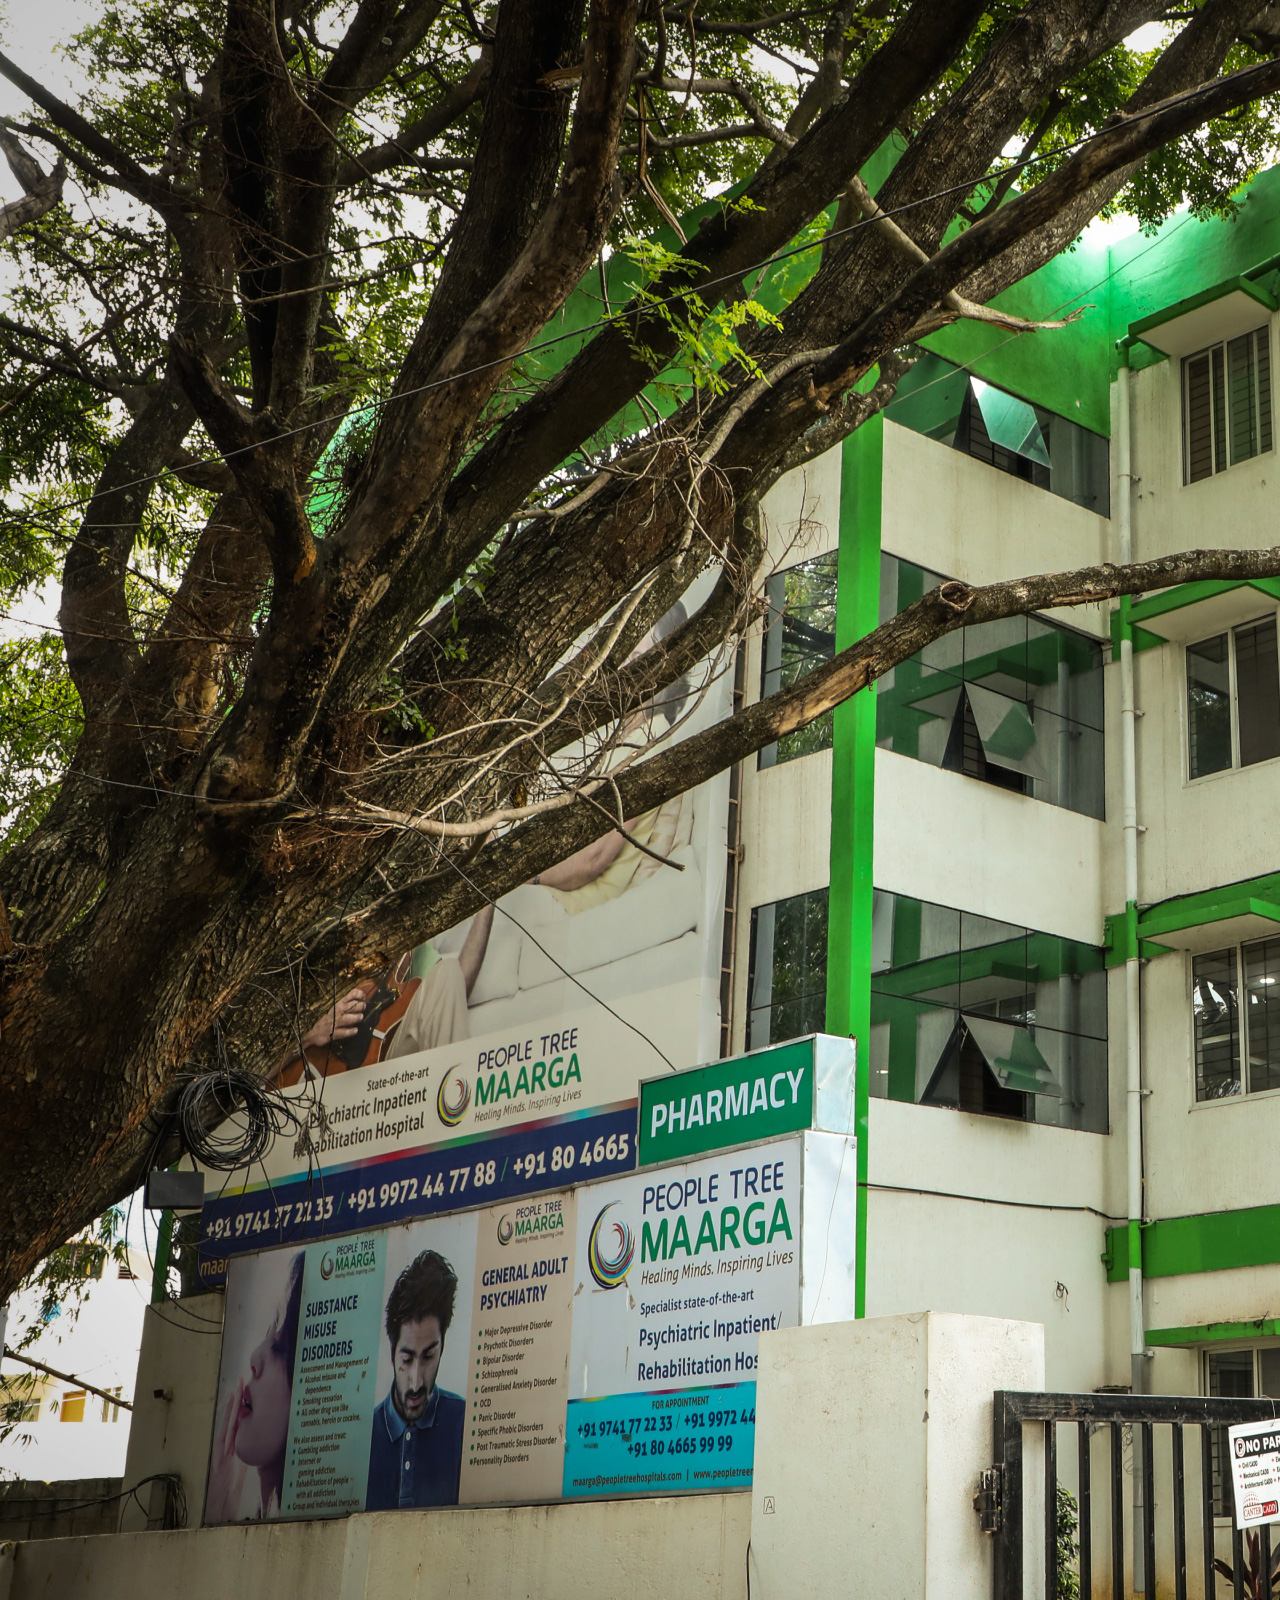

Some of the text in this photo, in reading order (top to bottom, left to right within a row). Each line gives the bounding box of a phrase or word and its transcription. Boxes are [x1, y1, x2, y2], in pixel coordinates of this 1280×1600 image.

[478, 1028, 578, 1072] PEOPLE TREE
[367, 1066, 430, 1092] State-of-the-art
[475, 1053, 582, 1107] MAARGA
[373, 1086, 427, 1116] Inpatient
[474, 1089, 582, 1123] Healing Minds. Inspiring Lives
[650, 1067, 805, 1138] PHARMACY
[375, 1111, 424, 1140] Hospital
[513, 1151, 547, 1179] +91
[551, 1145, 575, 1172] 80
[580, 1133, 630, 1167] 4665
[348, 1160, 496, 1214] +91 9972 44 77 88
[643, 1161, 784, 1215] PEOPLE TREE
[207, 1196, 334, 1240] +91 9741 77 22 33
[516, 1200, 563, 1219] PEOPLE TREE
[515, 1212, 564, 1236] MAARGA
[641, 1197, 793, 1264] MAARGA
[337, 1239, 375, 1256] PEOPLE TREE
[335, 1251, 376, 1272] MAARGA
[482, 1256, 569, 1287] GENERAL ADULT
[641, 1249, 794, 1286] Healing Minds. Inspiring Lives
[306, 1294, 359, 1318] SUBSTANCE
[480, 1284, 548, 1311] PSYCHIATRY
[640, 1289, 755, 1318] Specialist state-of-the-art
[304, 1320, 338, 1340] MISUSE
[484, 1319, 553, 1338] Major Depressive Disorder
[639, 1321, 710, 1350] Psychiatric
[302, 1340, 353, 1362] DISORDERS
[484, 1337, 534, 1352] Psychotic Disorders
[483, 1352, 525, 1367] Bipolar Disorder
[638, 1355, 731, 1382] Rehabilitation
[481, 1367, 518, 1380] Schizophrenia
[481, 1377, 557, 1394] Generalised Anxiety Disorder
[480, 1399, 492, 1408] OCD
[652, 1395, 710, 1410] FOR APPOINTMENT
[479, 1410, 516, 1422] Panic Disorder
[577, 1415, 673, 1439] +91 9741 77 22 33
[684, 1412, 705, 1429] +91
[708, 1410, 737, 1428] 9972
[478, 1422, 544, 1439] Specific Phobic Disorders
[477, 1435, 557, 1451] Post Traumatic Stress Disorder
[627, 1435, 733, 1458] +91 80 4665 99 99
[1245, 1439, 1260, 1453] NO
[473, 1452, 530, 1466] Personality Disorders
[573, 1471, 682, 1488] maarga@peopletreehospitals.com
[1243, 1503, 1276, 1518] CANTER CADD
